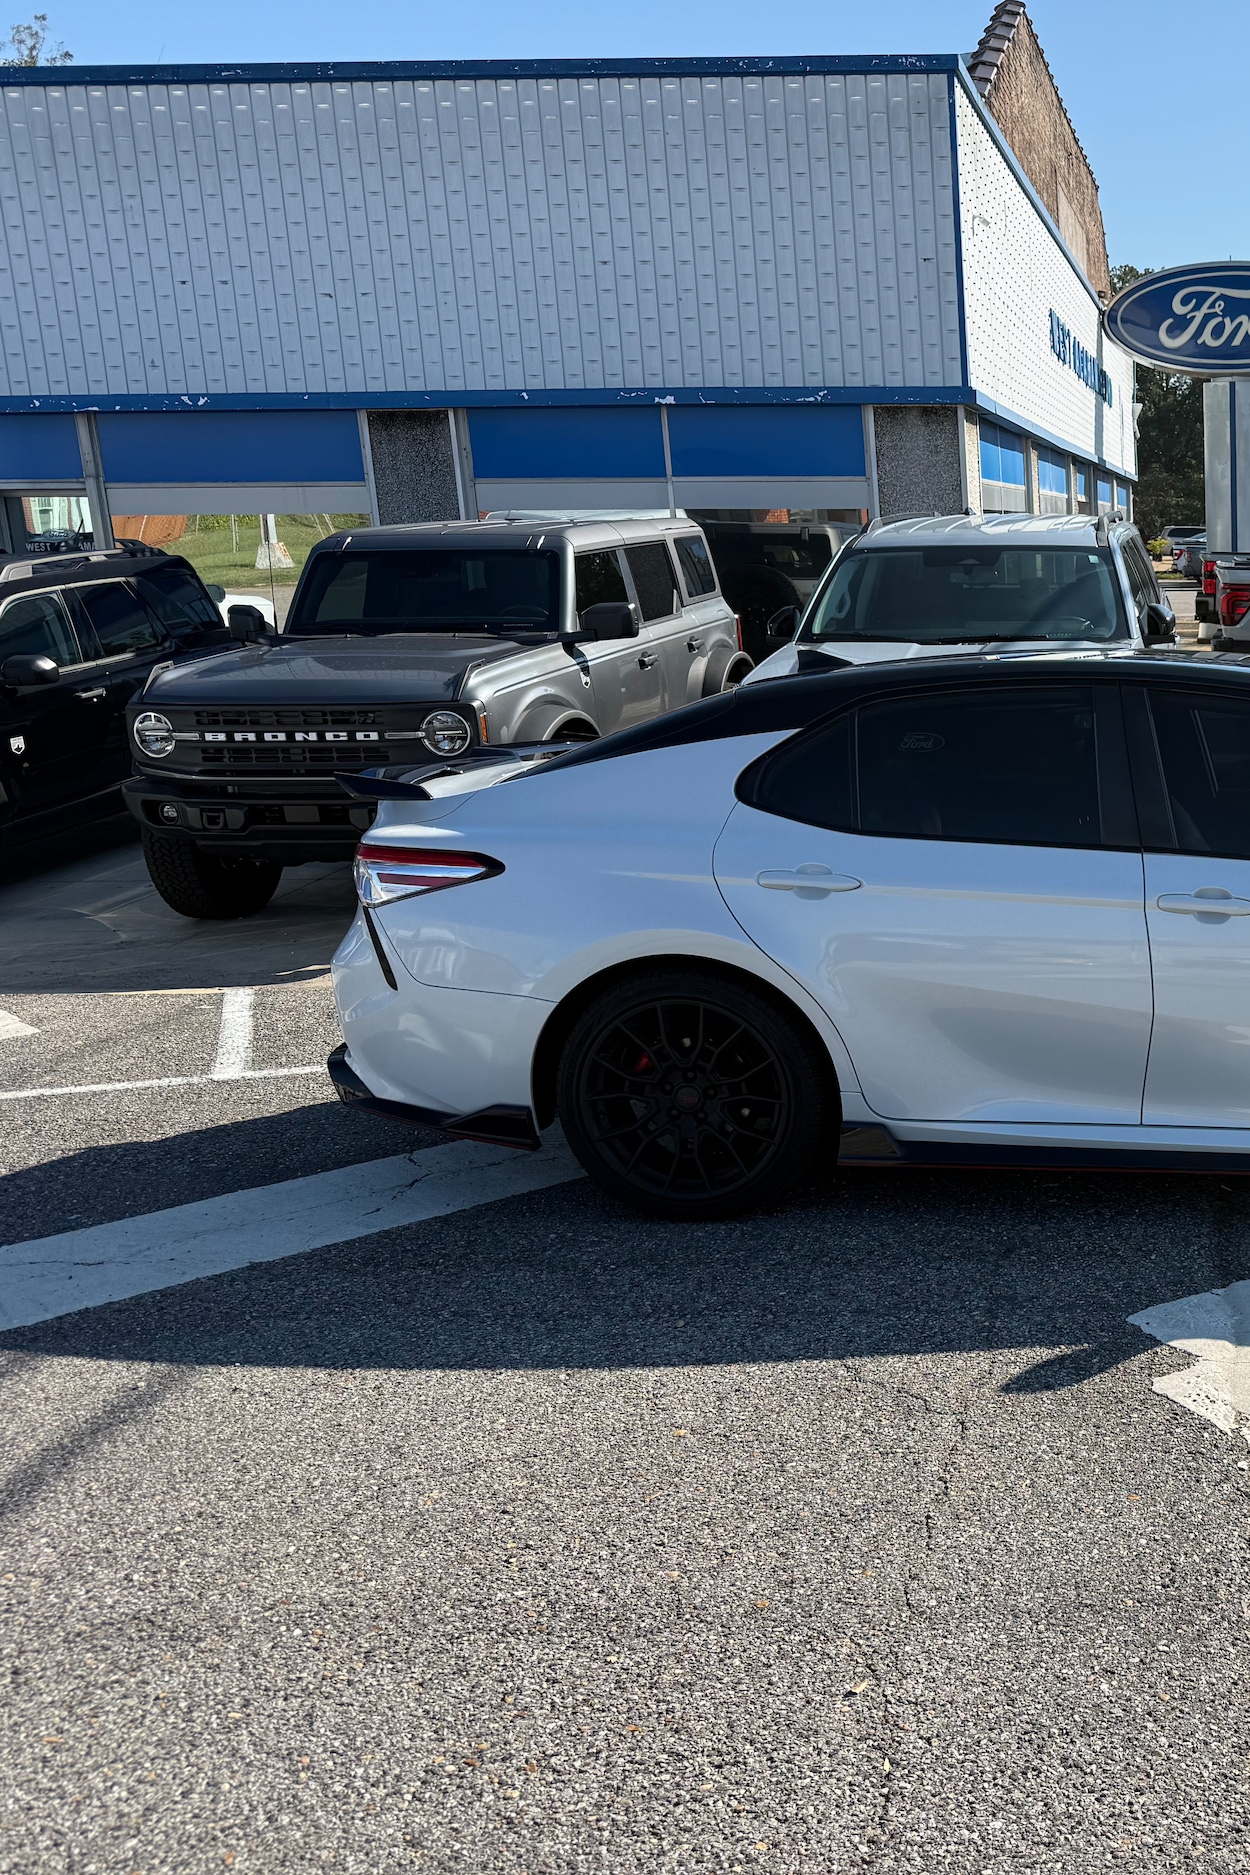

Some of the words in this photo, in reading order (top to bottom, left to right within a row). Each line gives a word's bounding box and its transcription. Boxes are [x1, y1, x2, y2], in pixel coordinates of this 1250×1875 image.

[25, 543, 51, 552] WEST
[204, 732, 379, 741] BRONCO
[900, 734, 934, 749] Ford
